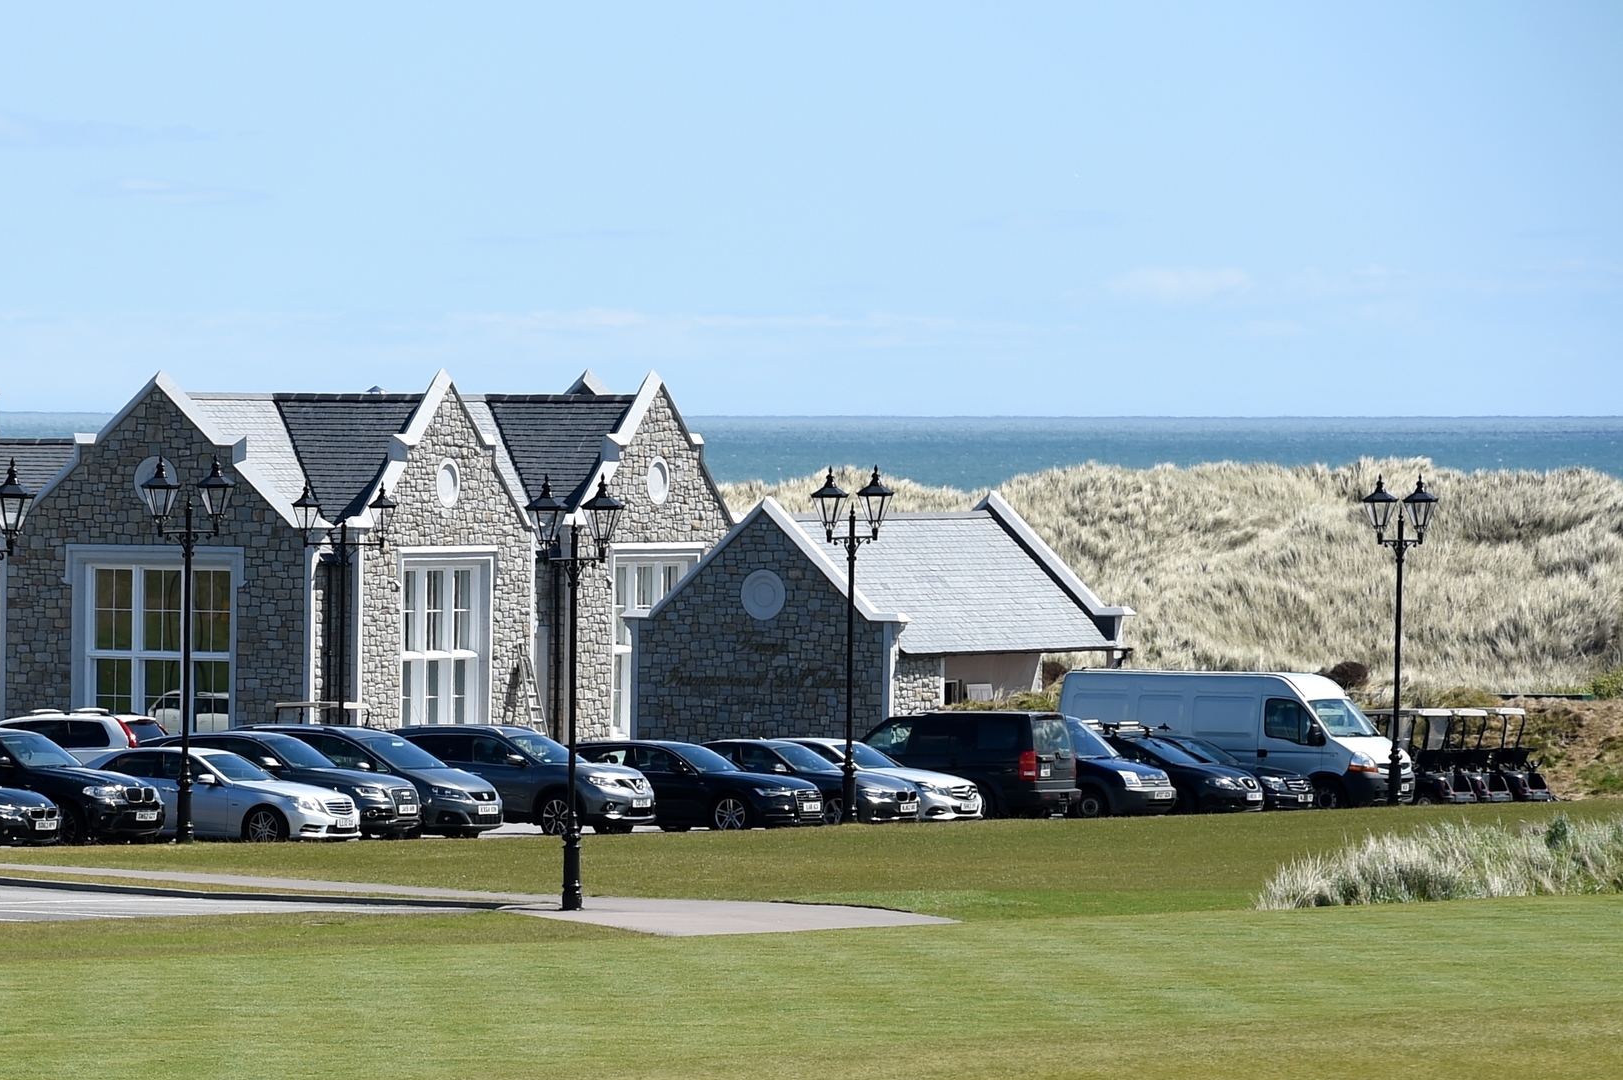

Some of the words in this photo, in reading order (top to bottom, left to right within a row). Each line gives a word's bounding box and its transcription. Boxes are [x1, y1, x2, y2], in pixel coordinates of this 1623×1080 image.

[731, 631, 788, 659] Trump
[665, 663, 771, 687] International
[772, 665, 812, 691] Golf
